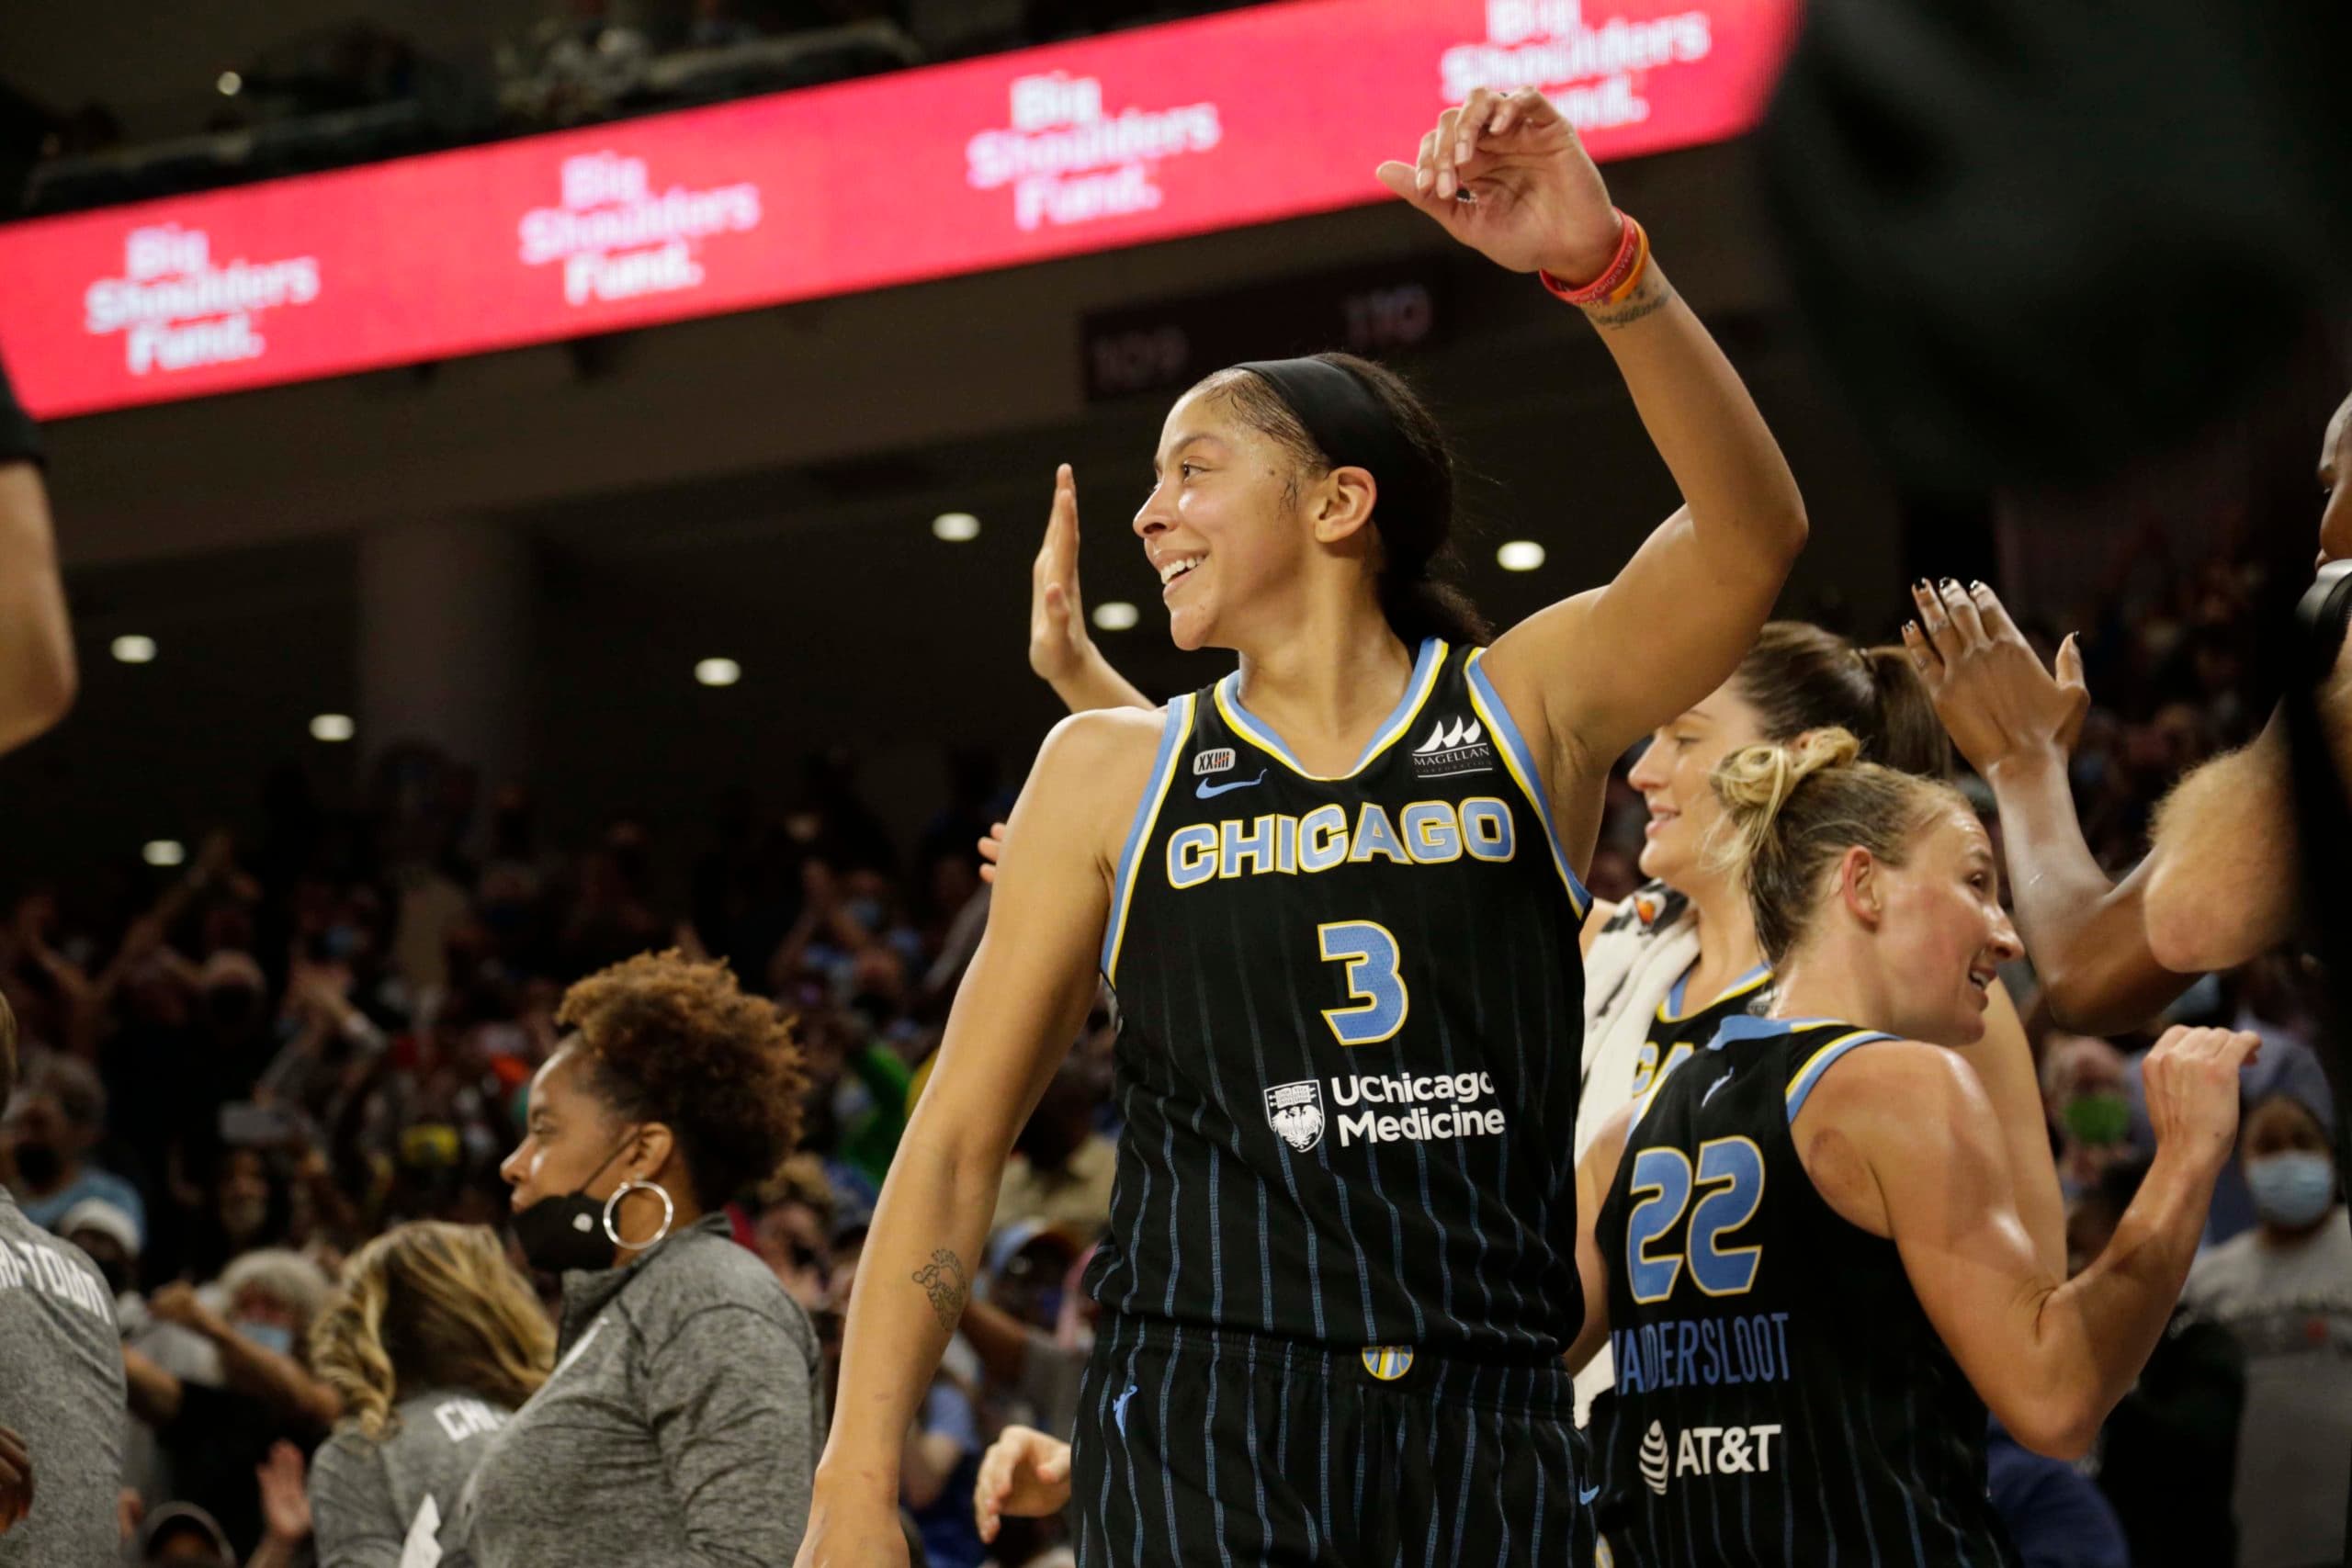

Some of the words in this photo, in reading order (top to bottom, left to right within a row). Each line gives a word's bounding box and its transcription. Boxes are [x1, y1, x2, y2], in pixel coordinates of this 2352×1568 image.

[1441, 10, 1712, 103] Shoulders
[1012, 69, 1102, 131] Big
[562, 149, 648, 209] Big
[967, 101, 1223, 190] Shoulders
[518, 182, 762, 265] Shoulders
[1014, 162, 1163, 231] Fund.
[126, 220, 209, 281] Big
[564, 237, 705, 307] Fund.
[85, 255, 320, 334] Shoulders
[128, 310, 266, 377] Fund.
[1414, 747, 1490, 766] MAGELLAN
[1166, 796, 1516, 889] CHICAGO
[1317, 919, 1409, 1046] 3
[1337, 1104, 1506, 1146] Medicine
[1625, 1134, 1766, 1304] 22
[1676, 1424, 1781, 1477] AT&T
